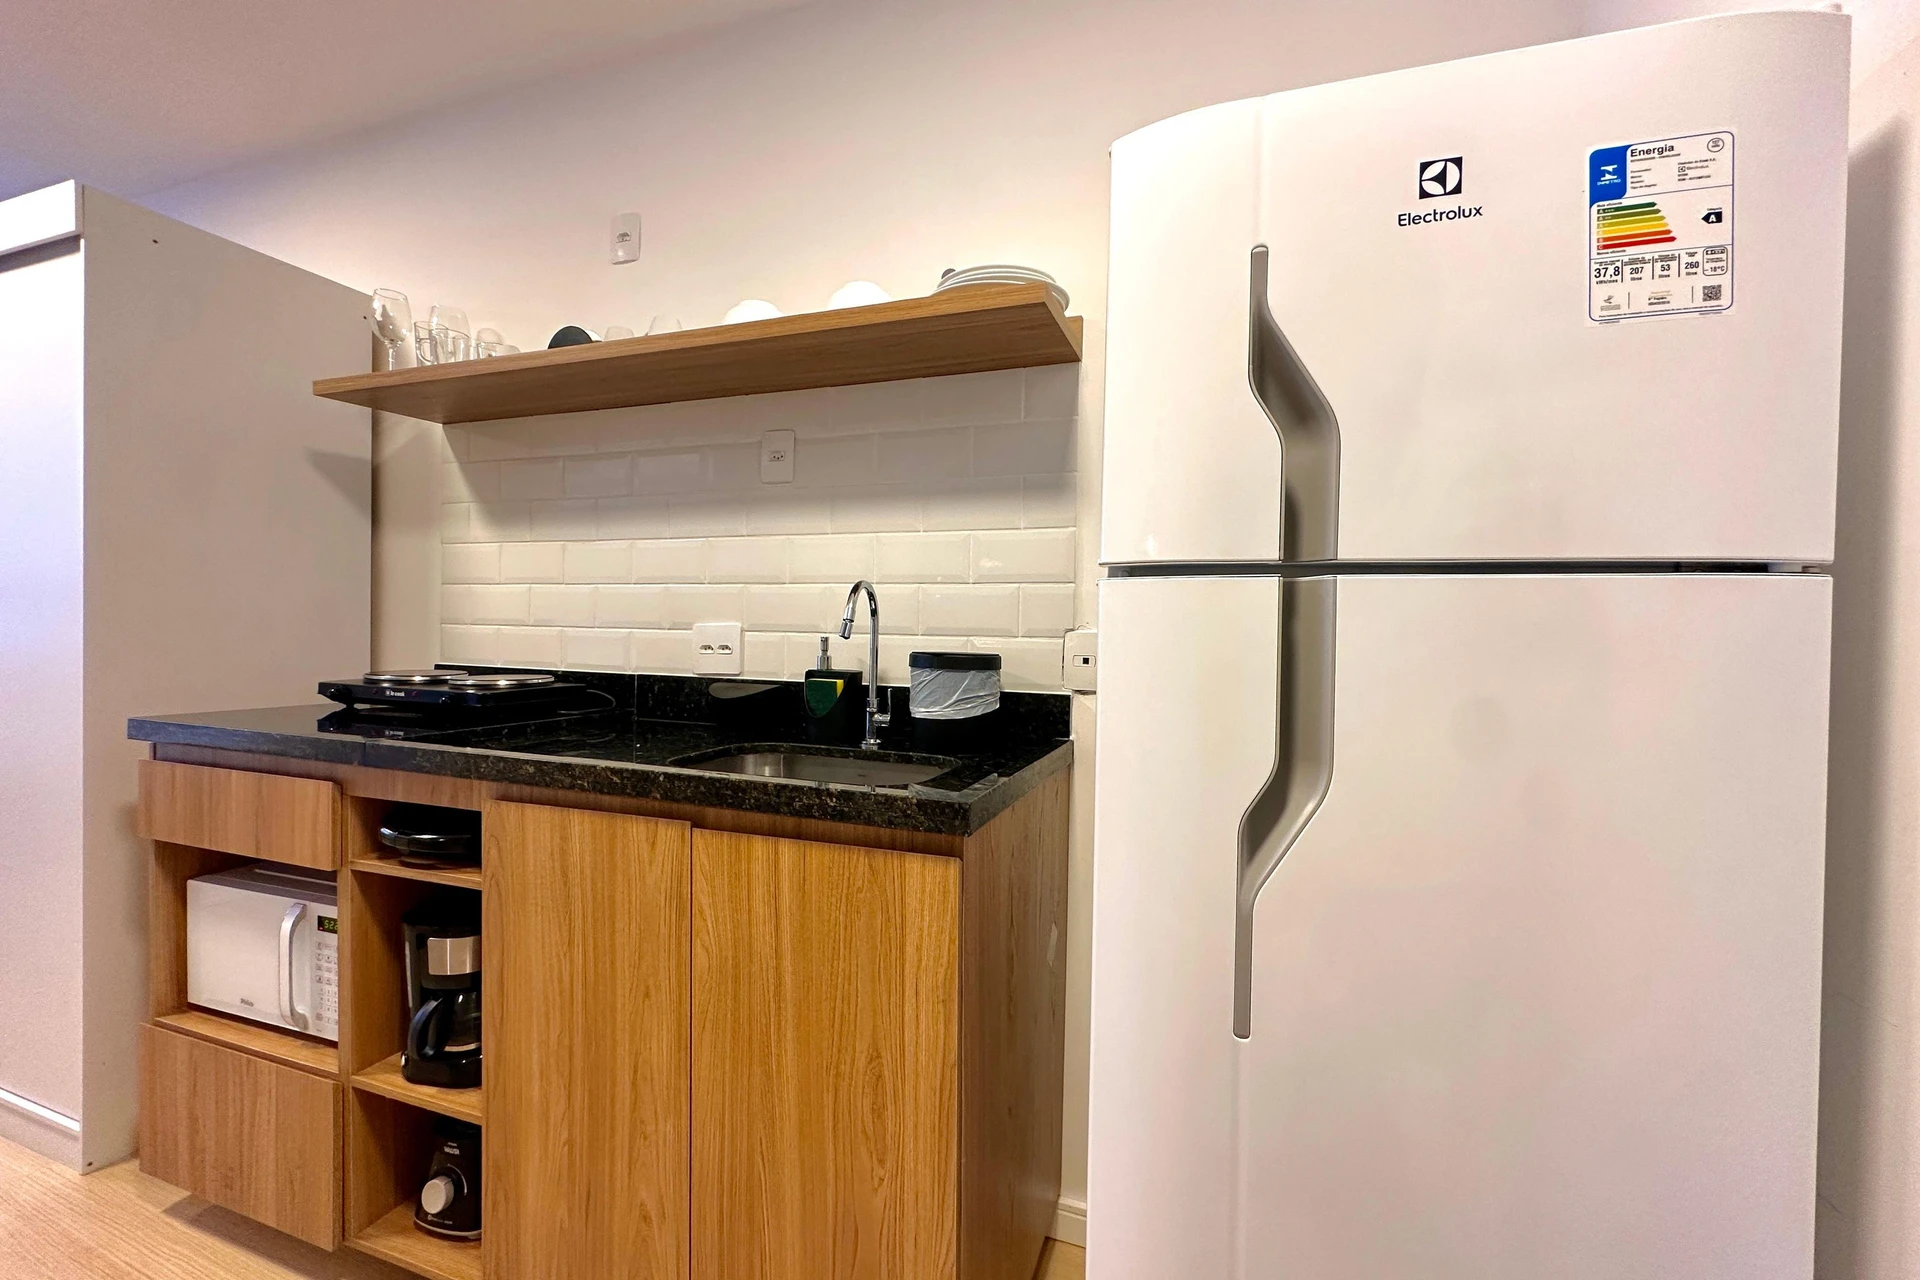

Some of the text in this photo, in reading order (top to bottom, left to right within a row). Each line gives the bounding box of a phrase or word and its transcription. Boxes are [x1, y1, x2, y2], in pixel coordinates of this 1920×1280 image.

[1630, 144, 1674, 158] Energia
[1398, 205, 1483, 227] Electrolux
[1708, 214, 1717, 223] A
[1660, 263, 1671, 272] 53
[1684, 260, 1700, 270] 260
[1594, 265, 1620, 279] 37,8
[1629, 266, 1644, 275] 207
